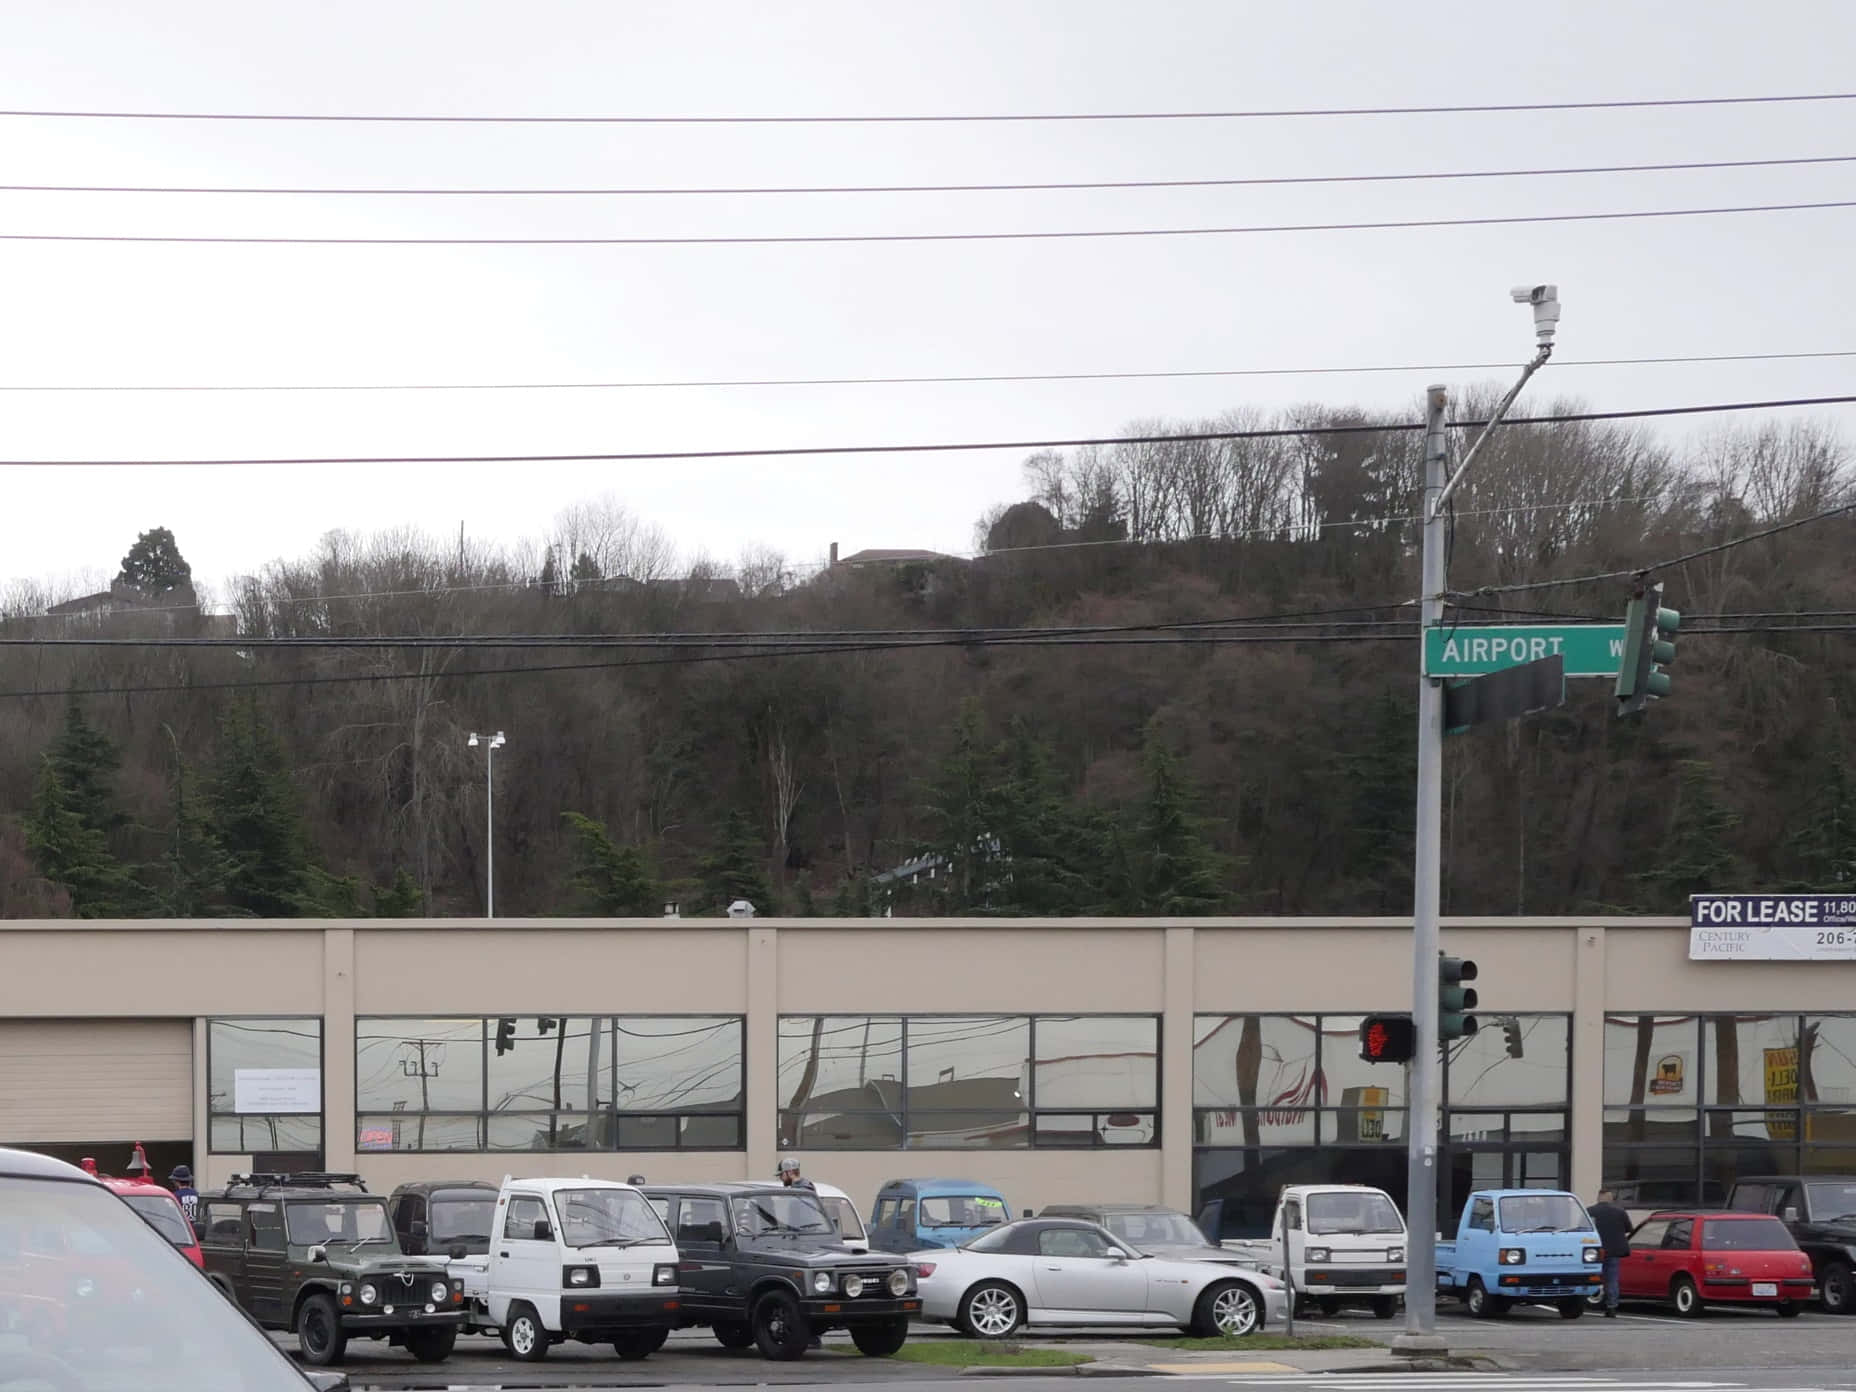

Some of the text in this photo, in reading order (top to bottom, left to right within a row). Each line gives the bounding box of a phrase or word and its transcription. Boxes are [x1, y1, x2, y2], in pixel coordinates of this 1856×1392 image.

[1442, 637, 1564, 663] AIRPORT
[1697, 901, 1819, 923] FOR LEASE
[1698, 930, 1752, 942] CENTURY
[1817, 932, 1856, 945] 206-
[1703, 941, 1746, 953] PACIFIC
[359, 1129, 393, 1145] OPEN
